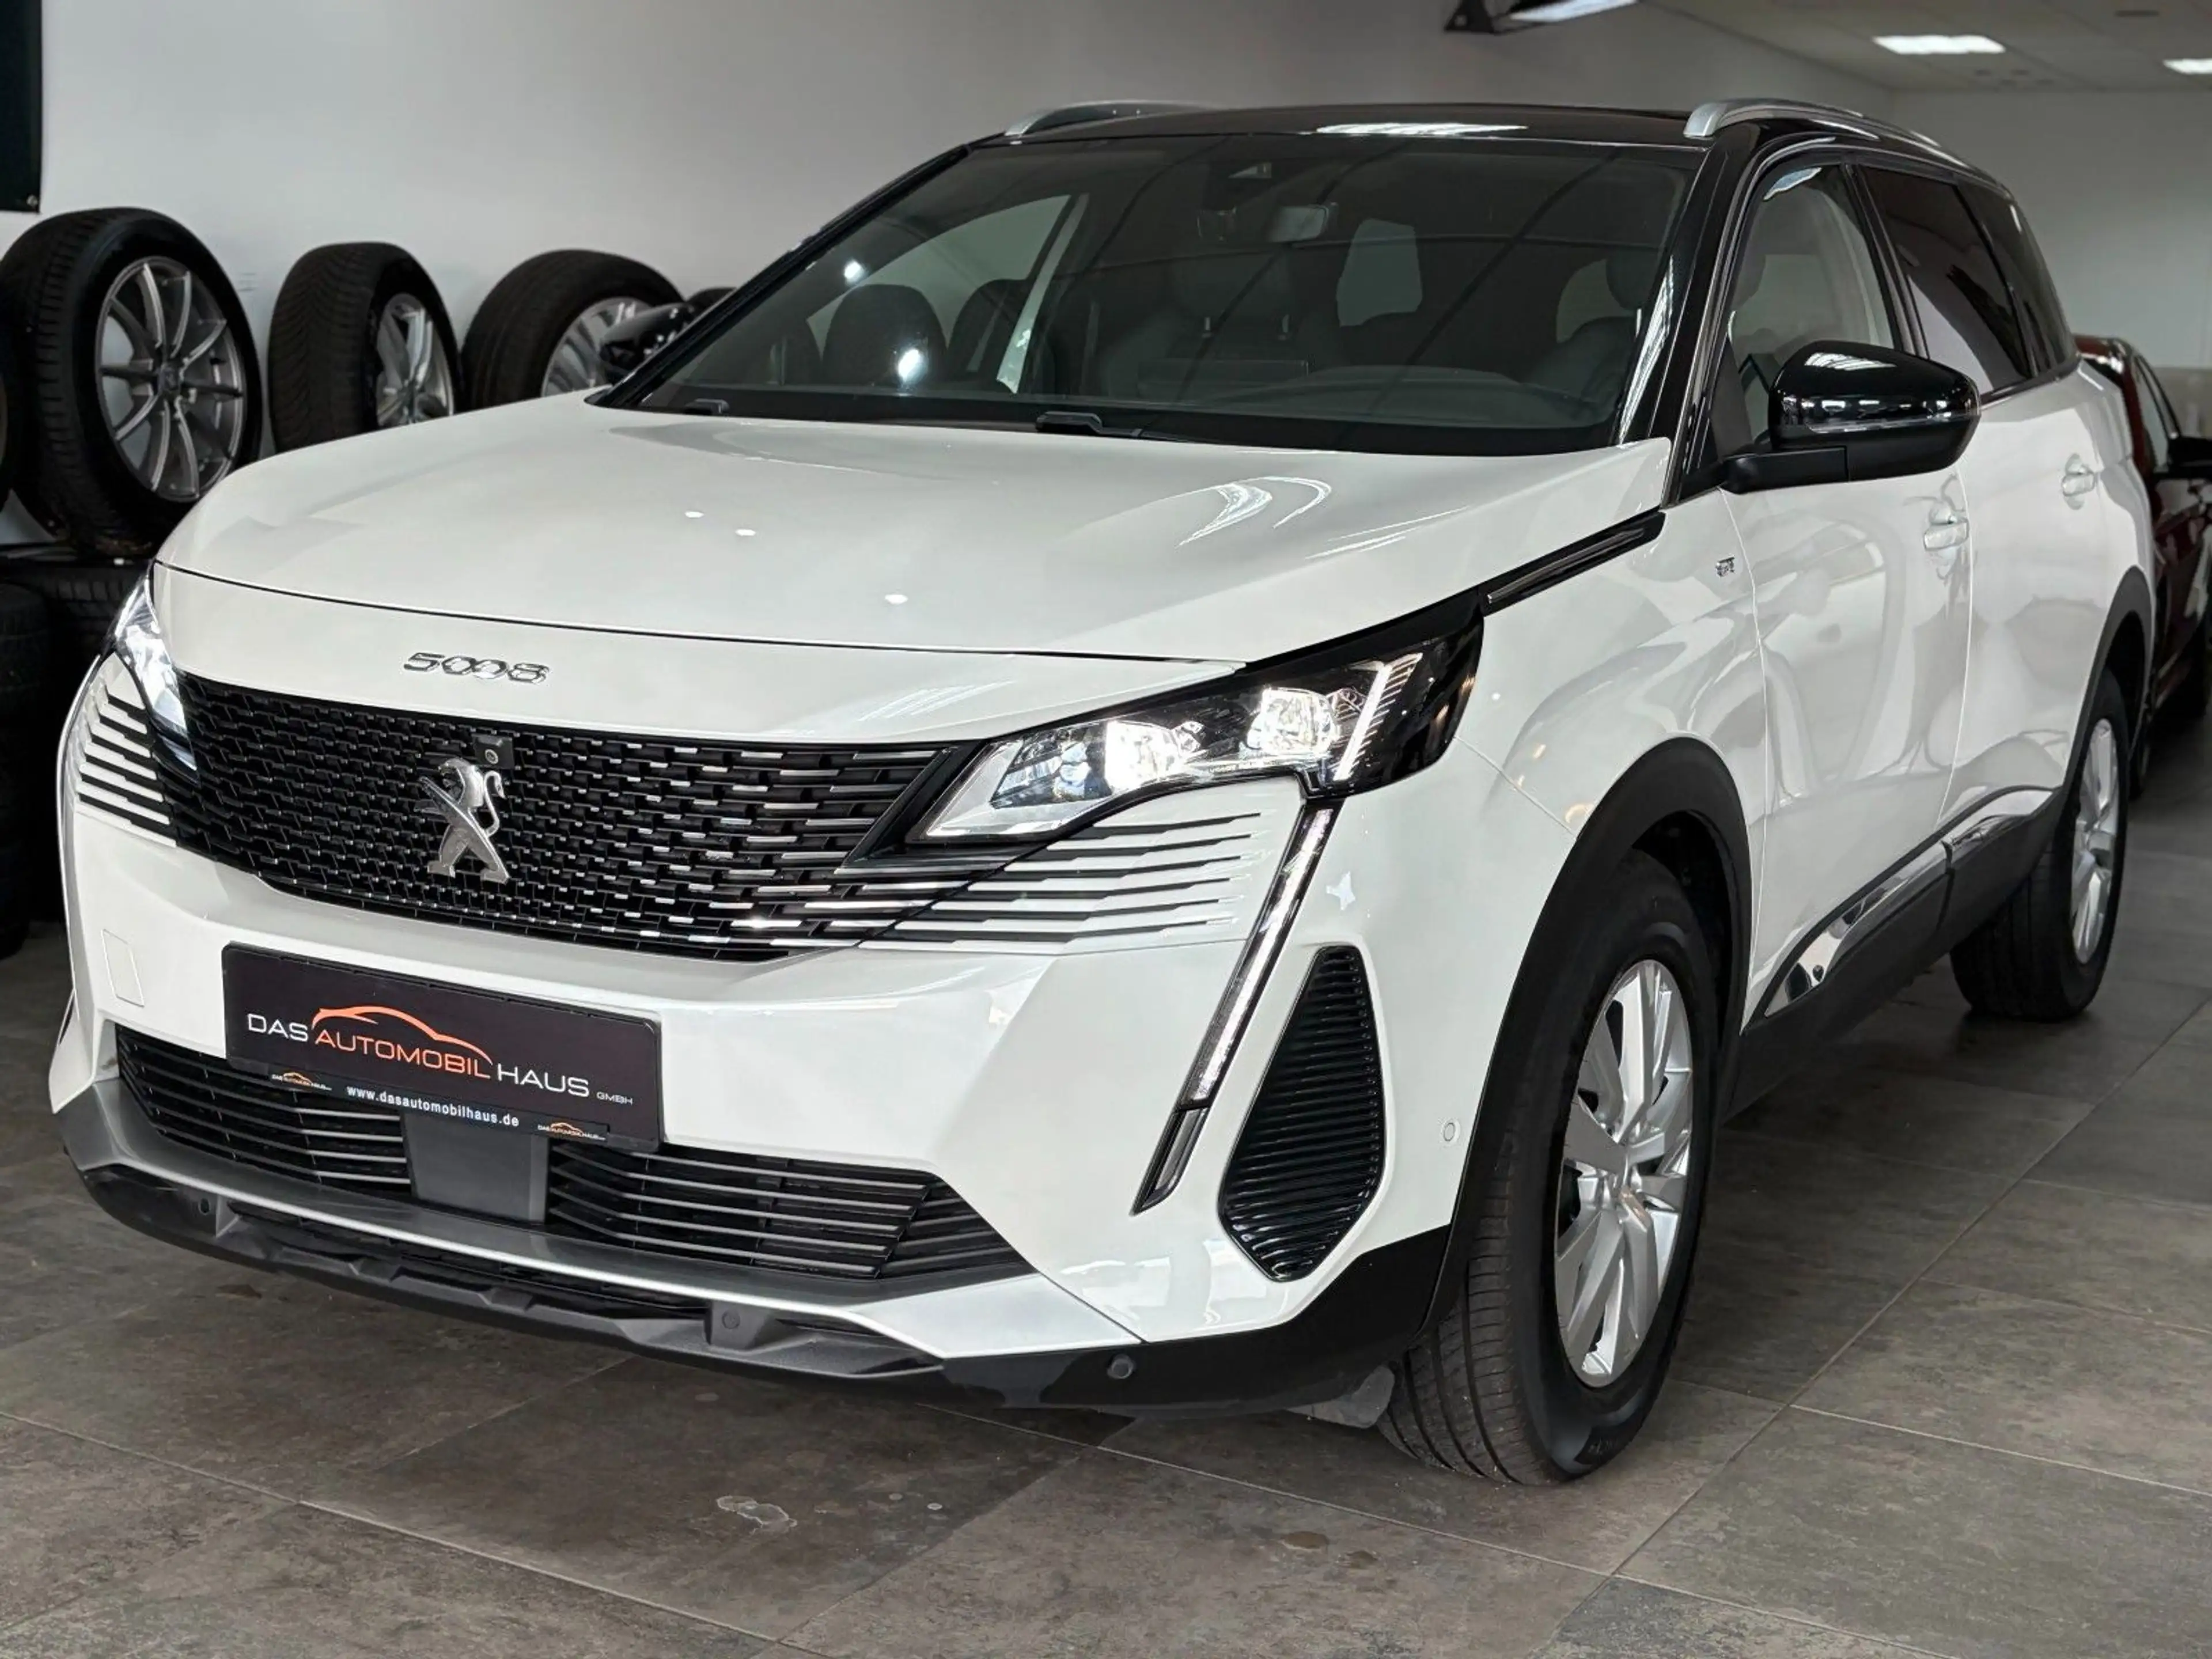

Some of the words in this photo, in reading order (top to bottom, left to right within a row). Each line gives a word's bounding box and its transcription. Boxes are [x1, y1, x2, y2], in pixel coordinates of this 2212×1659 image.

[404, 652, 550, 684] 5008
[248, 1013, 308, 1041] DAS
[315, 1030, 491, 1079] AUTOMOBIL
[498, 1063, 590, 1097] HAUS
[347, 1086, 519, 1127] www.dasautomobilhaus.de
